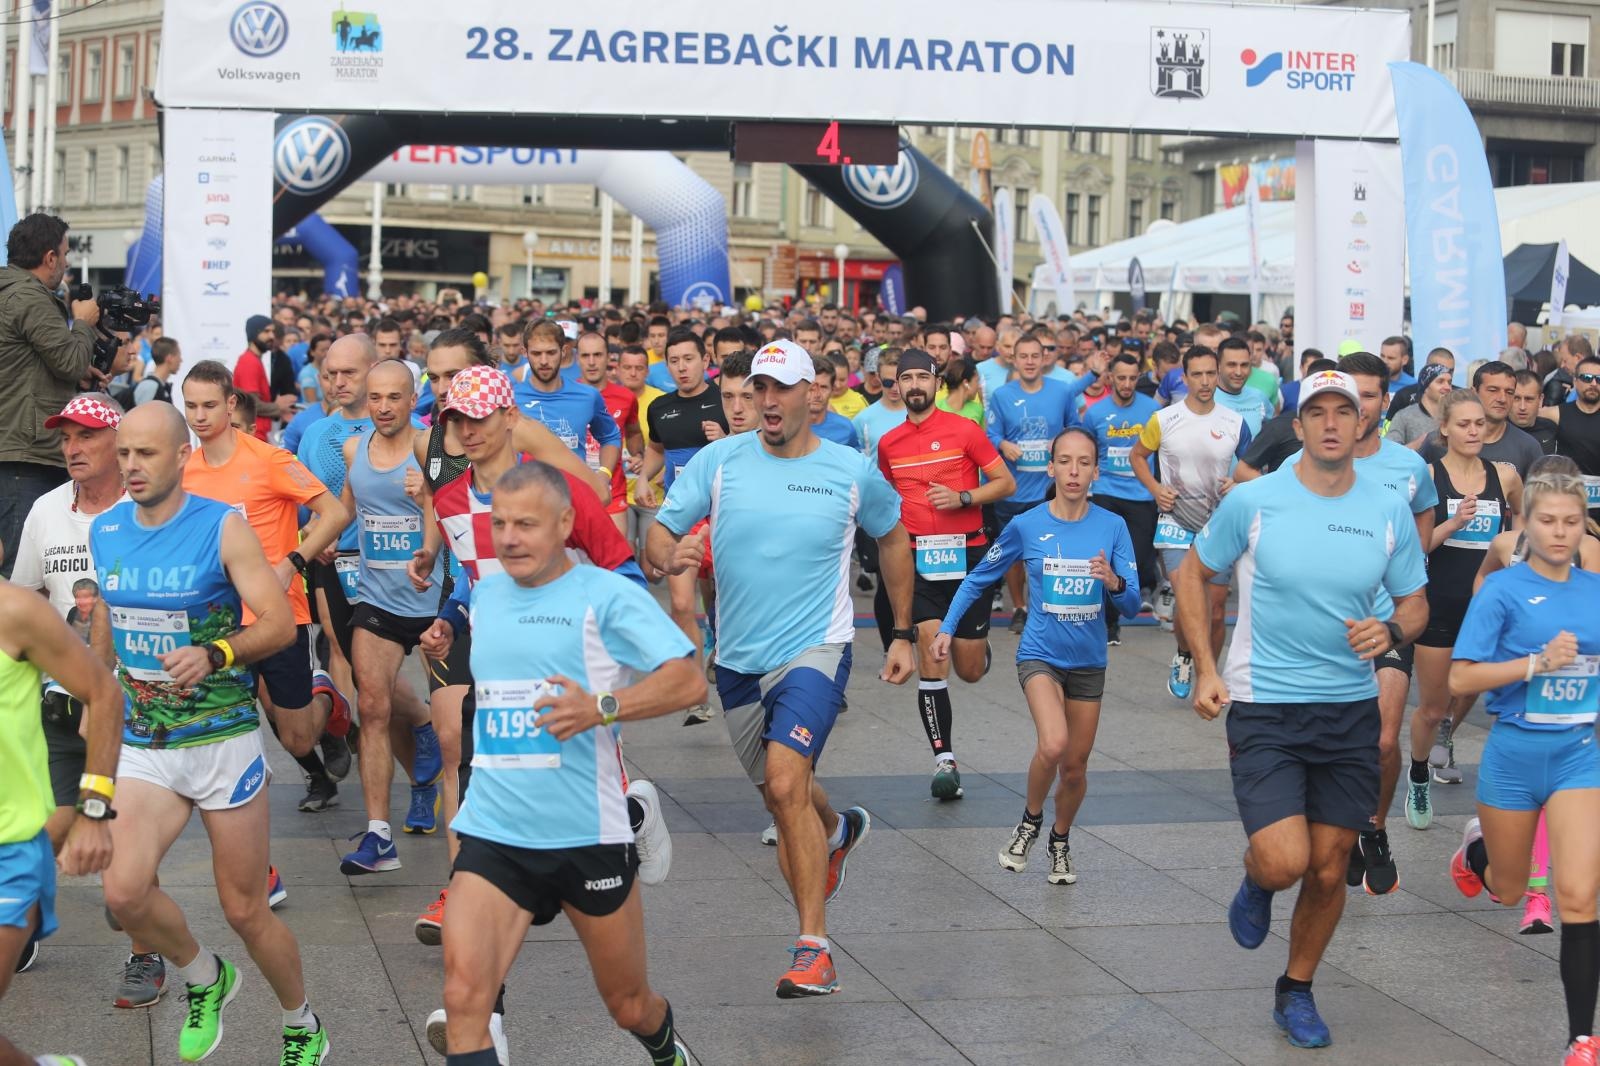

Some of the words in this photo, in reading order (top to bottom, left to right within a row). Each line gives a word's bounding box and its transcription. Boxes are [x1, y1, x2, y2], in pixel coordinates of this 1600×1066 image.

[466, 26, 533, 60] 28.
[548, 25, 838, 68] ZAGREBAČKI
[854, 37, 1075, 76] MARATON
[330, 56, 384, 67] ZAGREBAČKI
[1288, 51, 1356, 72] INTER
[218, 68, 301, 83] Volkswagen
[336, 68, 378, 78] MARATON
[1286, 72, 1355, 91] SPORT
[787, 484, 833, 496] GARMIN
[1159, 525, 1187, 541] 4819
[1327, 524, 1374, 538] GARMIN
[76, 545, 88, 554] NA
[373, 533, 411, 551] 5146
[924, 549, 958, 565] 4344
[146, 565, 198, 592] 047
[1053, 577, 1095, 596] 4287
[518, 616, 572, 627] GARMIN
[1057, 612, 1098, 622] MARATHON
[125, 632, 177, 657] 4470
[1541, 678, 1588, 701] 4567
[486, 710, 541, 738] 4199
